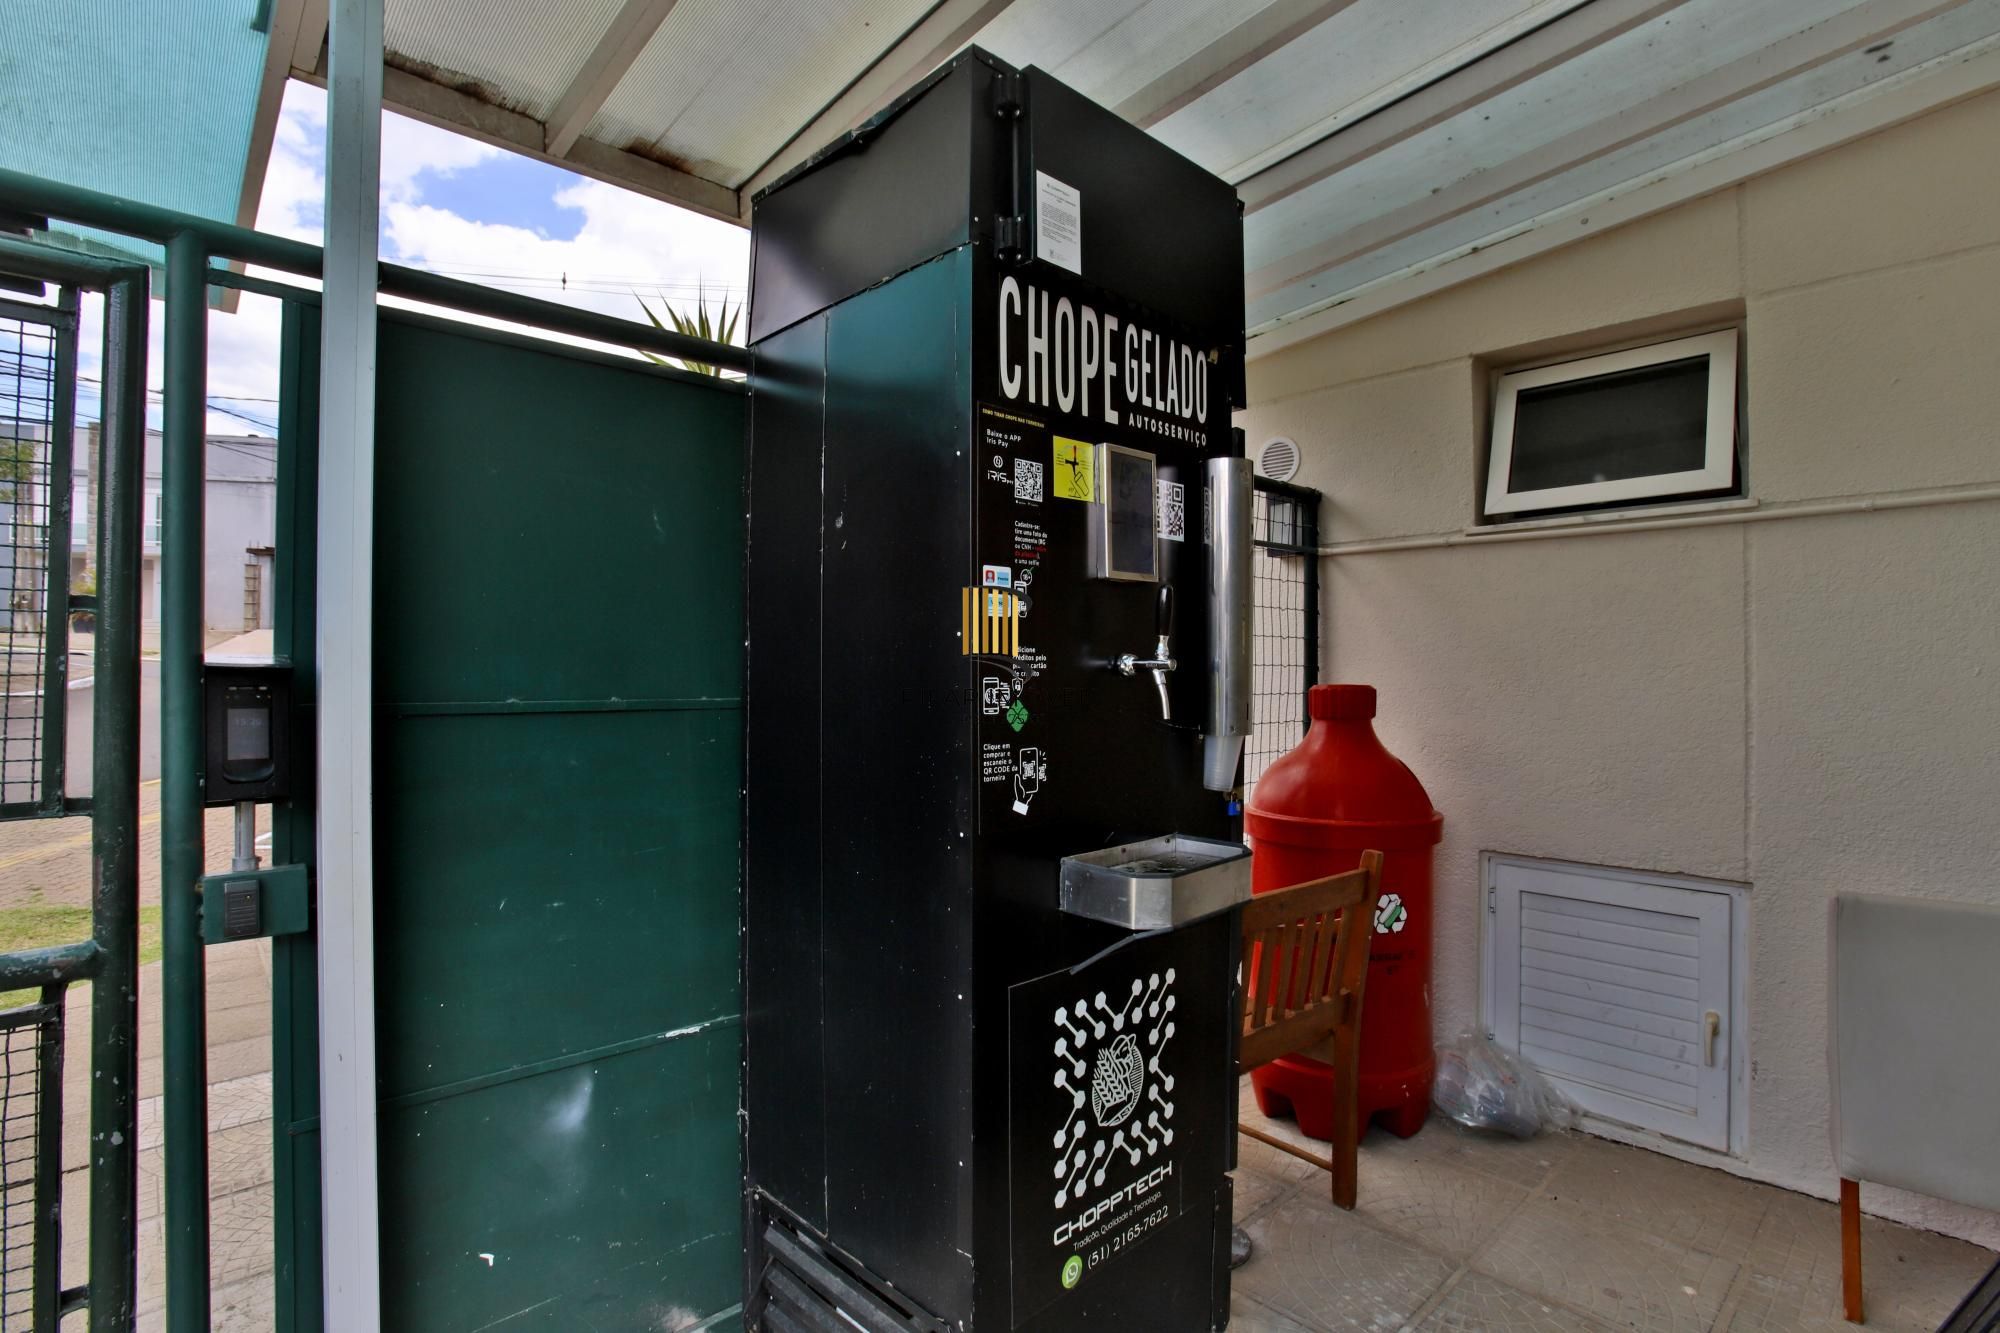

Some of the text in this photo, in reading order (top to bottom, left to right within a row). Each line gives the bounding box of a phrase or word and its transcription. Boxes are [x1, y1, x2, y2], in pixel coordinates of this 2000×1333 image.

[1000, 275, 1119, 425] CHOPE
[1125, 322, 1207, 424] GELADO
[987, 429, 1002, 438] Baixe
[998, 439, 1008, 448] Pay
[1128, 412, 1207, 448] AUTOSSERVIÇO
[1035, 654, 1047, 662] pelo
[1053, 1160, 1172, 1246] CHOPPTECH
[1087, 1205, 1169, 1269] (51) 2165-7622
[1101, 1213, 1129, 1234] Qualidade
